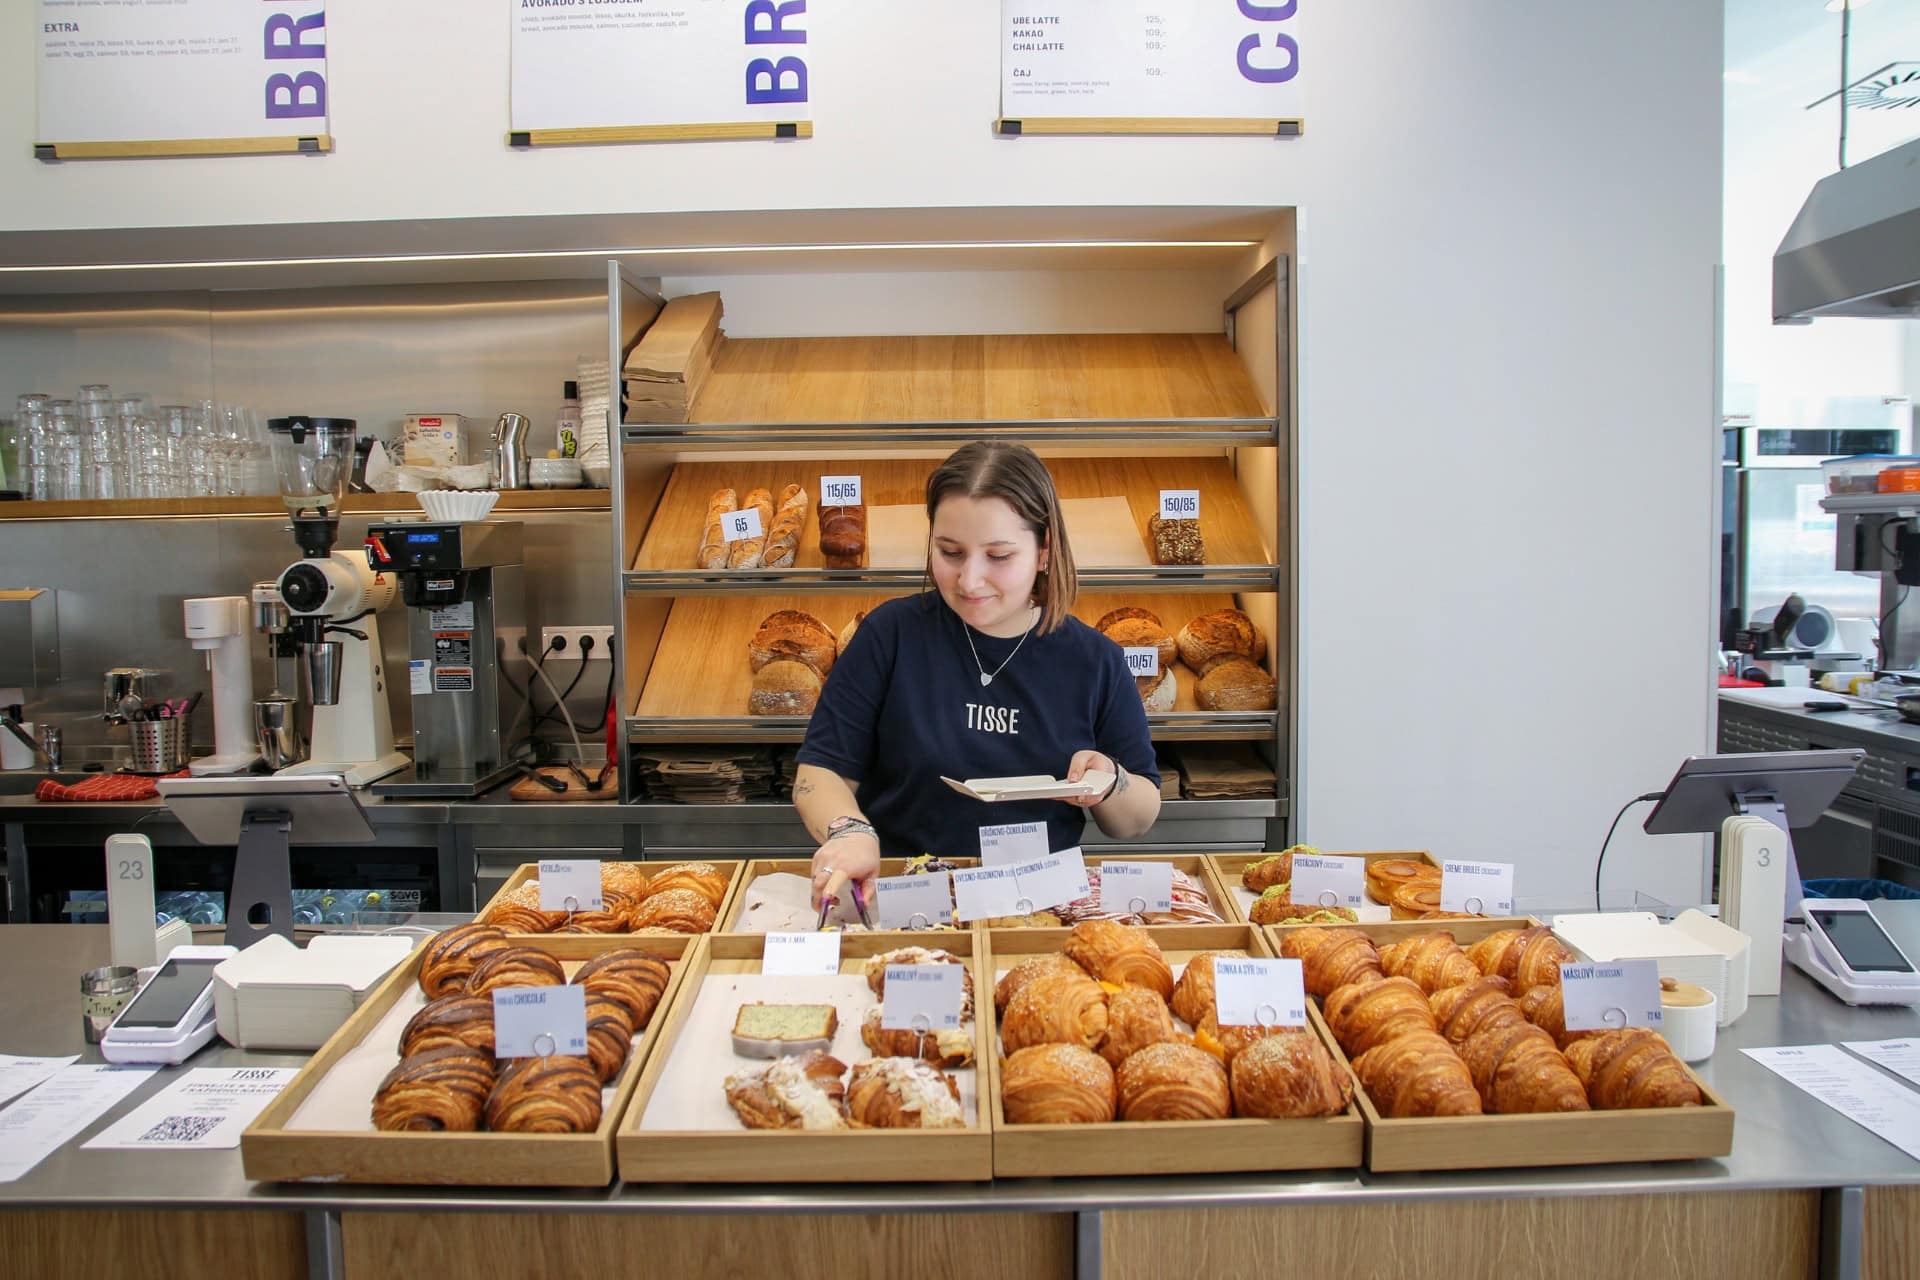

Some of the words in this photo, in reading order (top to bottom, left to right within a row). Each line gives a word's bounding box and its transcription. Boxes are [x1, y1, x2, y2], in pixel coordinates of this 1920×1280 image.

[1012, 16, 1030, 24] UBE
[1032, 16, 1060, 24] LATTE
[44, 23, 80, 33] EXTRA
[1012, 30, 1044, 38] KAKAO
[1012, 43, 1035, 51] CHAI
[1037, 43, 1065, 51] LATTE
[264, 0, 326, 119] BR
[826, 483, 856, 499] 115/65
[1164, 497, 1196, 512] 150/85
[734, 517, 748, 532] 65
[966, 703, 1020, 734] TISSE
[1757, 847, 1771, 867] 3
[119, 860, 144, 881] 23
[1563, 966, 1594, 979] MÁSLOVÝ
